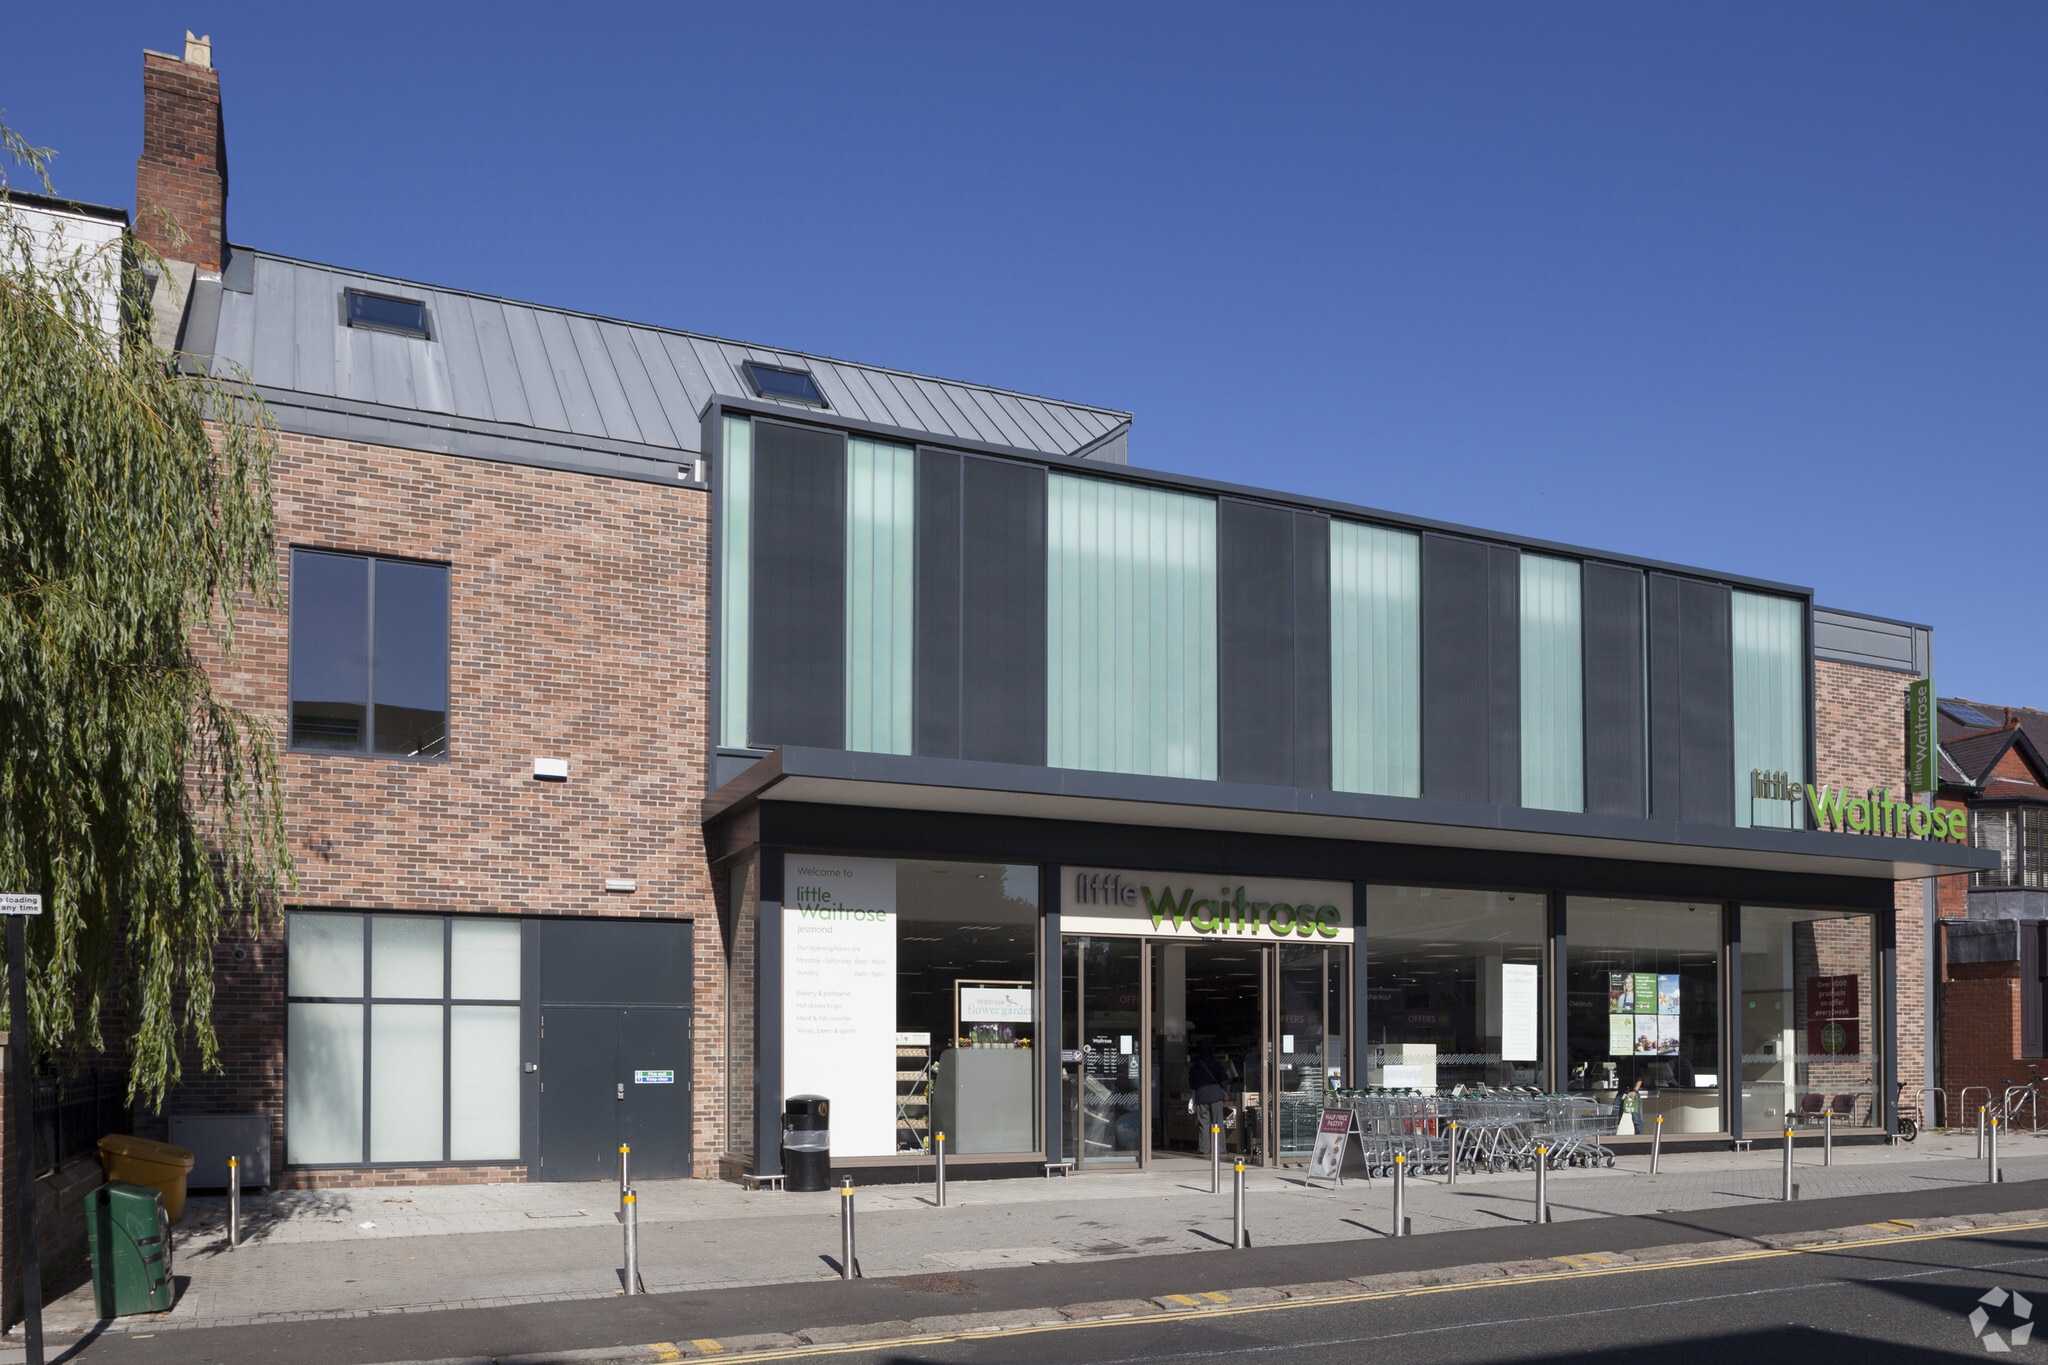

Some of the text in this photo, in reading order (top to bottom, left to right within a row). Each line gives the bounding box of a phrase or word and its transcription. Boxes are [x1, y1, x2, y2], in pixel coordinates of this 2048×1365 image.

[1914, 686, 1928, 787] little Waitrose
[1751, 768, 1967, 840] little Waitrose
[797, 866, 854, 878] Welcome to
[5, 896, 38, 905] loading
[796, 886, 831, 903] little
[1076, 872, 1342, 936] little Waitrose
[797, 902, 887, 922] Waitrose
[976, 997, 1005, 1006] Waitrose
[968, 1005, 1000, 1015] flower
[1408, 1014, 1436, 1024] OFFERS
[1336, 1114, 1349, 1122] PRICE
